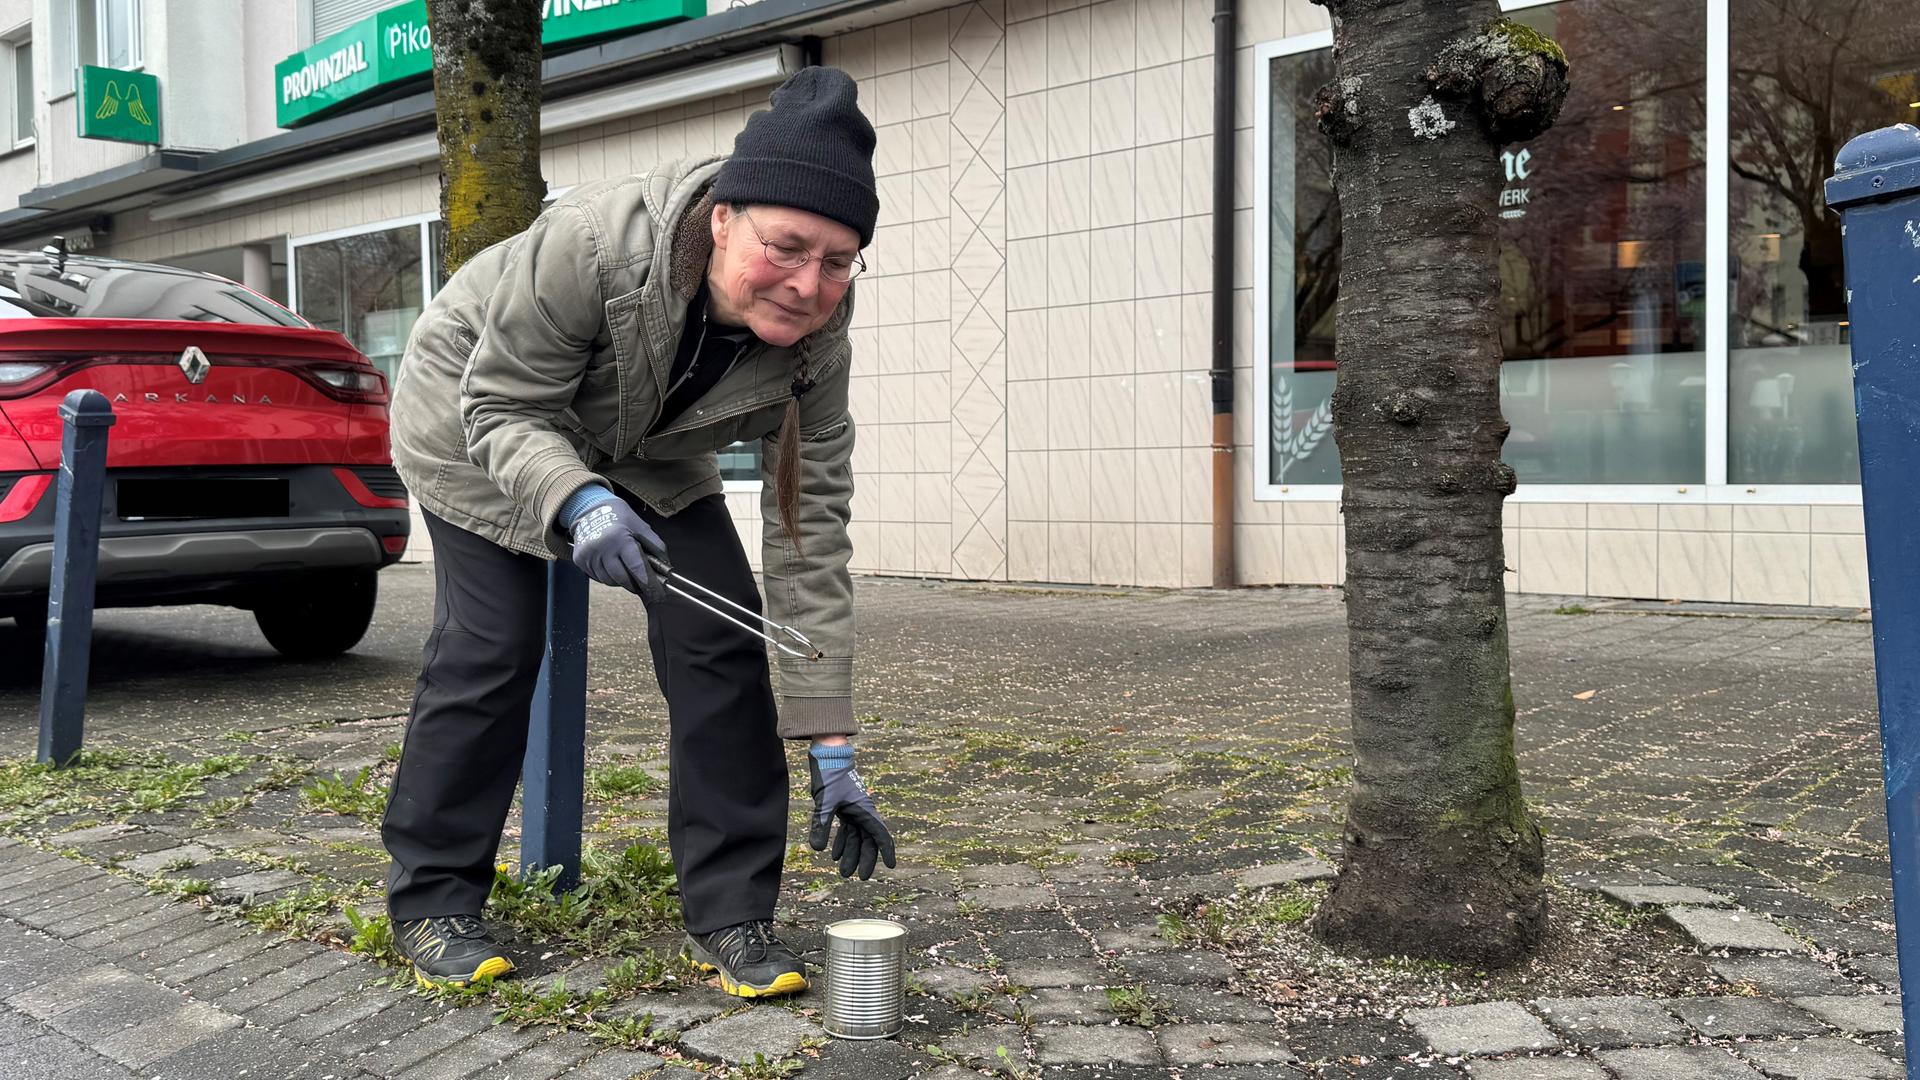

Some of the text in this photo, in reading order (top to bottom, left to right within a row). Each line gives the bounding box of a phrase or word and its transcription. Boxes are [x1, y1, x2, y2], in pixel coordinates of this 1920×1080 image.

[282, 40, 368, 105] PROVINZIAL
[1499, 187, 1531, 207] ERK
[112, 392, 273, 404] ARKANA
